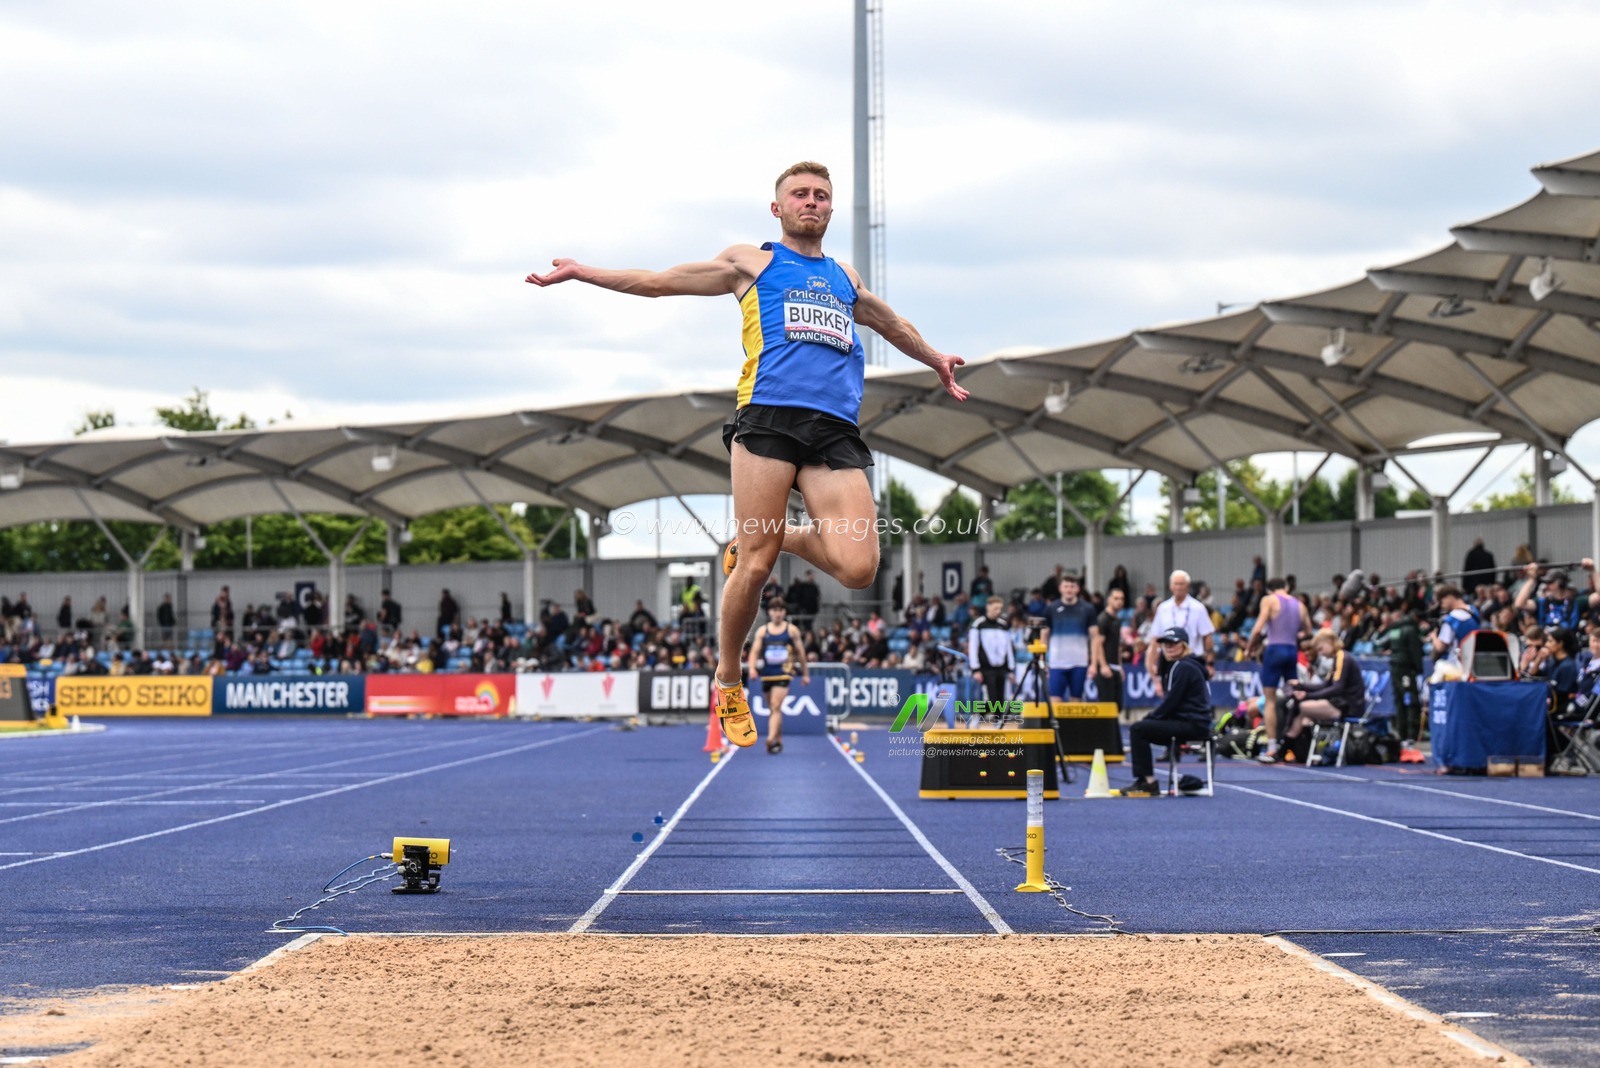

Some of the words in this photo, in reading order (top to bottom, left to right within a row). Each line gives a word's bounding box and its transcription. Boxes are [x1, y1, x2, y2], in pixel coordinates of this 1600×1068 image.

[789, 306, 850, 335] BURKEY
[790, 331, 850, 353] MANCHESTER
[945, 568, 960, 594] D
[58, 685, 132, 707] SEIKO
[136, 685, 209, 707] SEIKO
[226, 681, 349, 708] MANCHESTER
[826, 677, 899, 707] CHESTER
